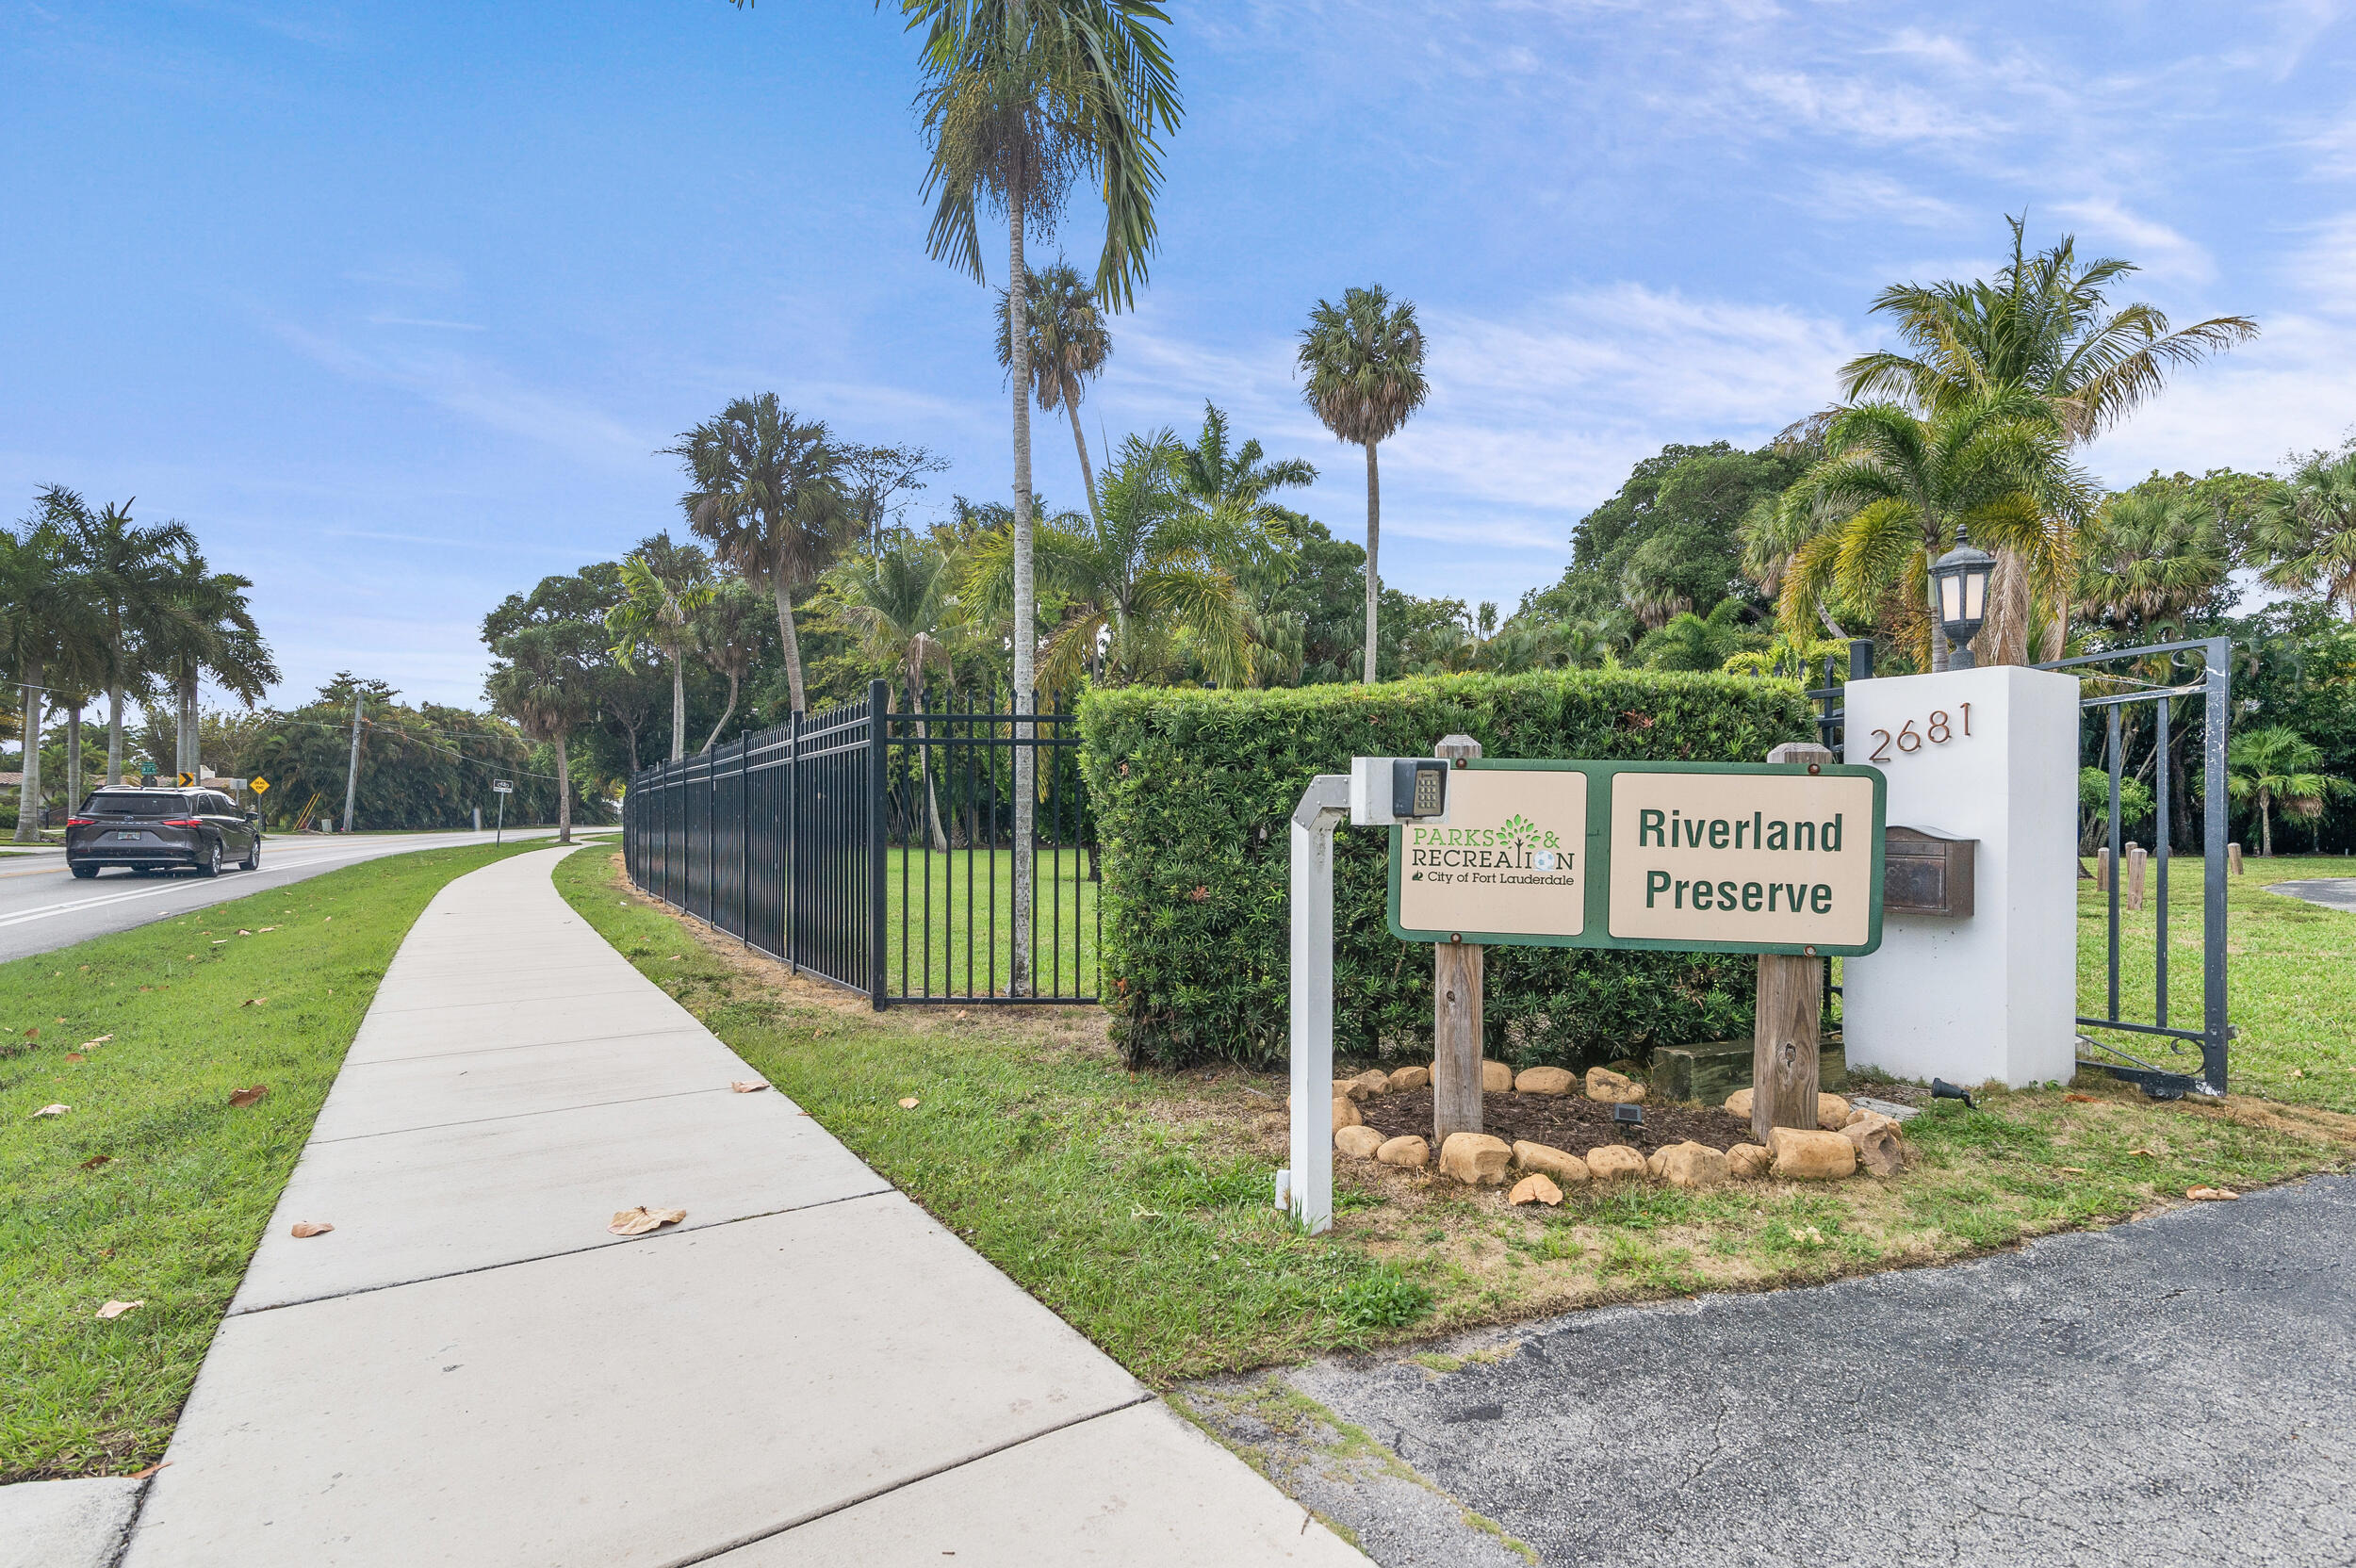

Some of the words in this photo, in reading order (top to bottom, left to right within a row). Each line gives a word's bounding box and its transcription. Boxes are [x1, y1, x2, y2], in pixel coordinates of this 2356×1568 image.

[1869, 702, 1972, 762] 2681
[1413, 827, 1495, 847] PARKS
[1543, 830, 1561, 849] &
[1639, 808, 1843, 854] Riverland
[1428, 871, 1453, 885] City
[1457, 872, 1469, 883] of
[1472, 873, 1497, 884] Fort
[1499, 873, 1575, 886] Lauderdale
[1645, 870, 1834, 915] Preserve
